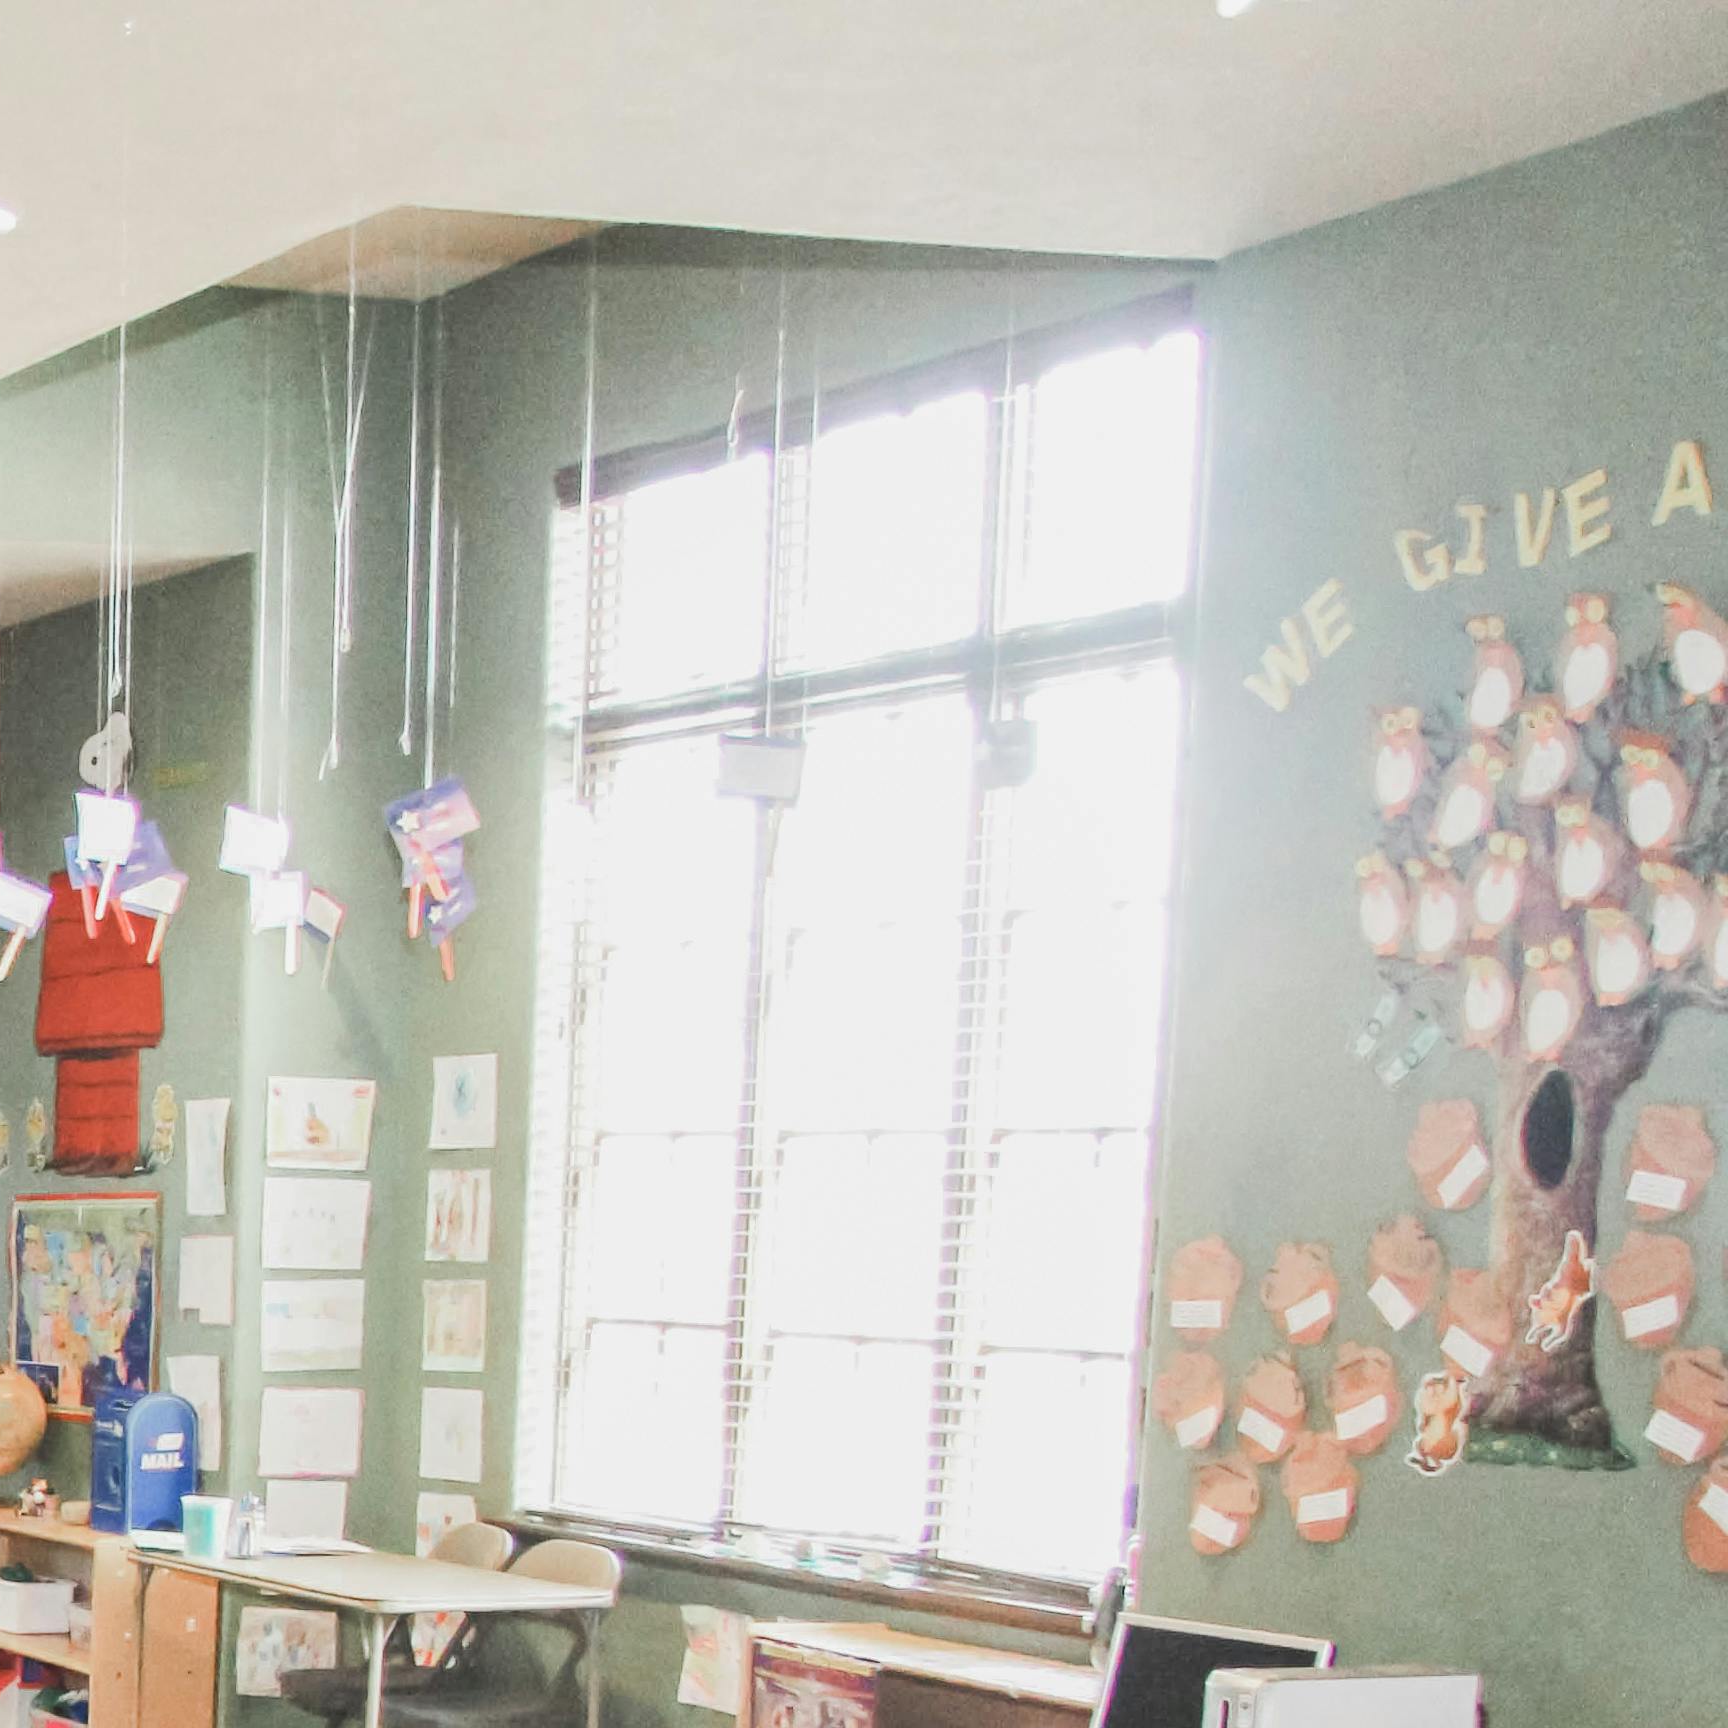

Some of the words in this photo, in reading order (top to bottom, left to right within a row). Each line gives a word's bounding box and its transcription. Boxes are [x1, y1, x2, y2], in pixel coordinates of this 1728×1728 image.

[1243, 577, 1354, 713] WE
[1394, 469, 1612, 591] GIVE
[1651, 440, 1713, 527] A
[140, 1451, 185, 1471] MAIL
